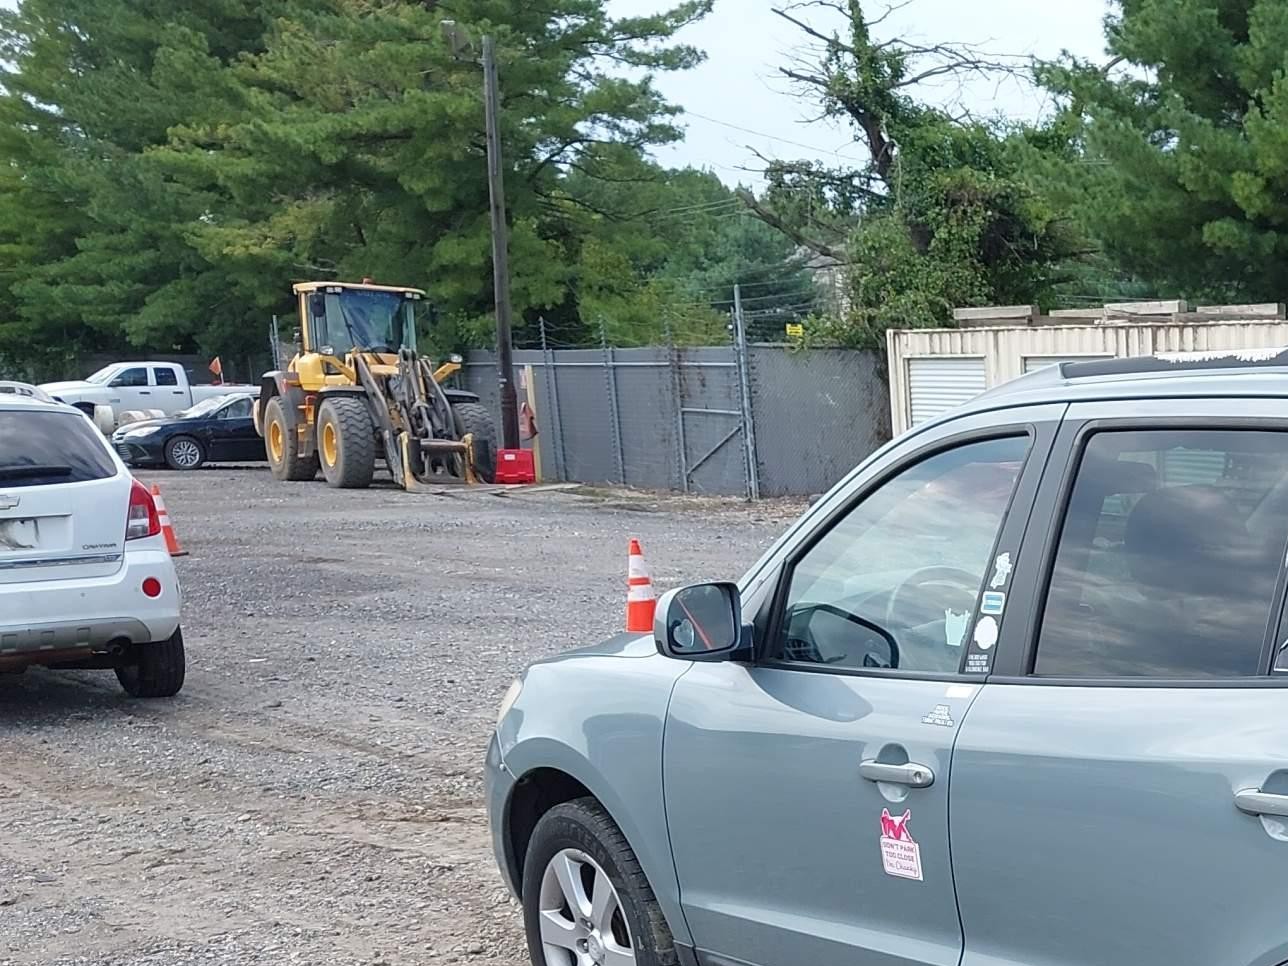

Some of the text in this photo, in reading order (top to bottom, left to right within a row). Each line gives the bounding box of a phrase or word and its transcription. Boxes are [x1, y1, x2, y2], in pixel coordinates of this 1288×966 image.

[900, 844, 915, 853] PARK
[885, 850, 915, 862] TOO CLOSE
